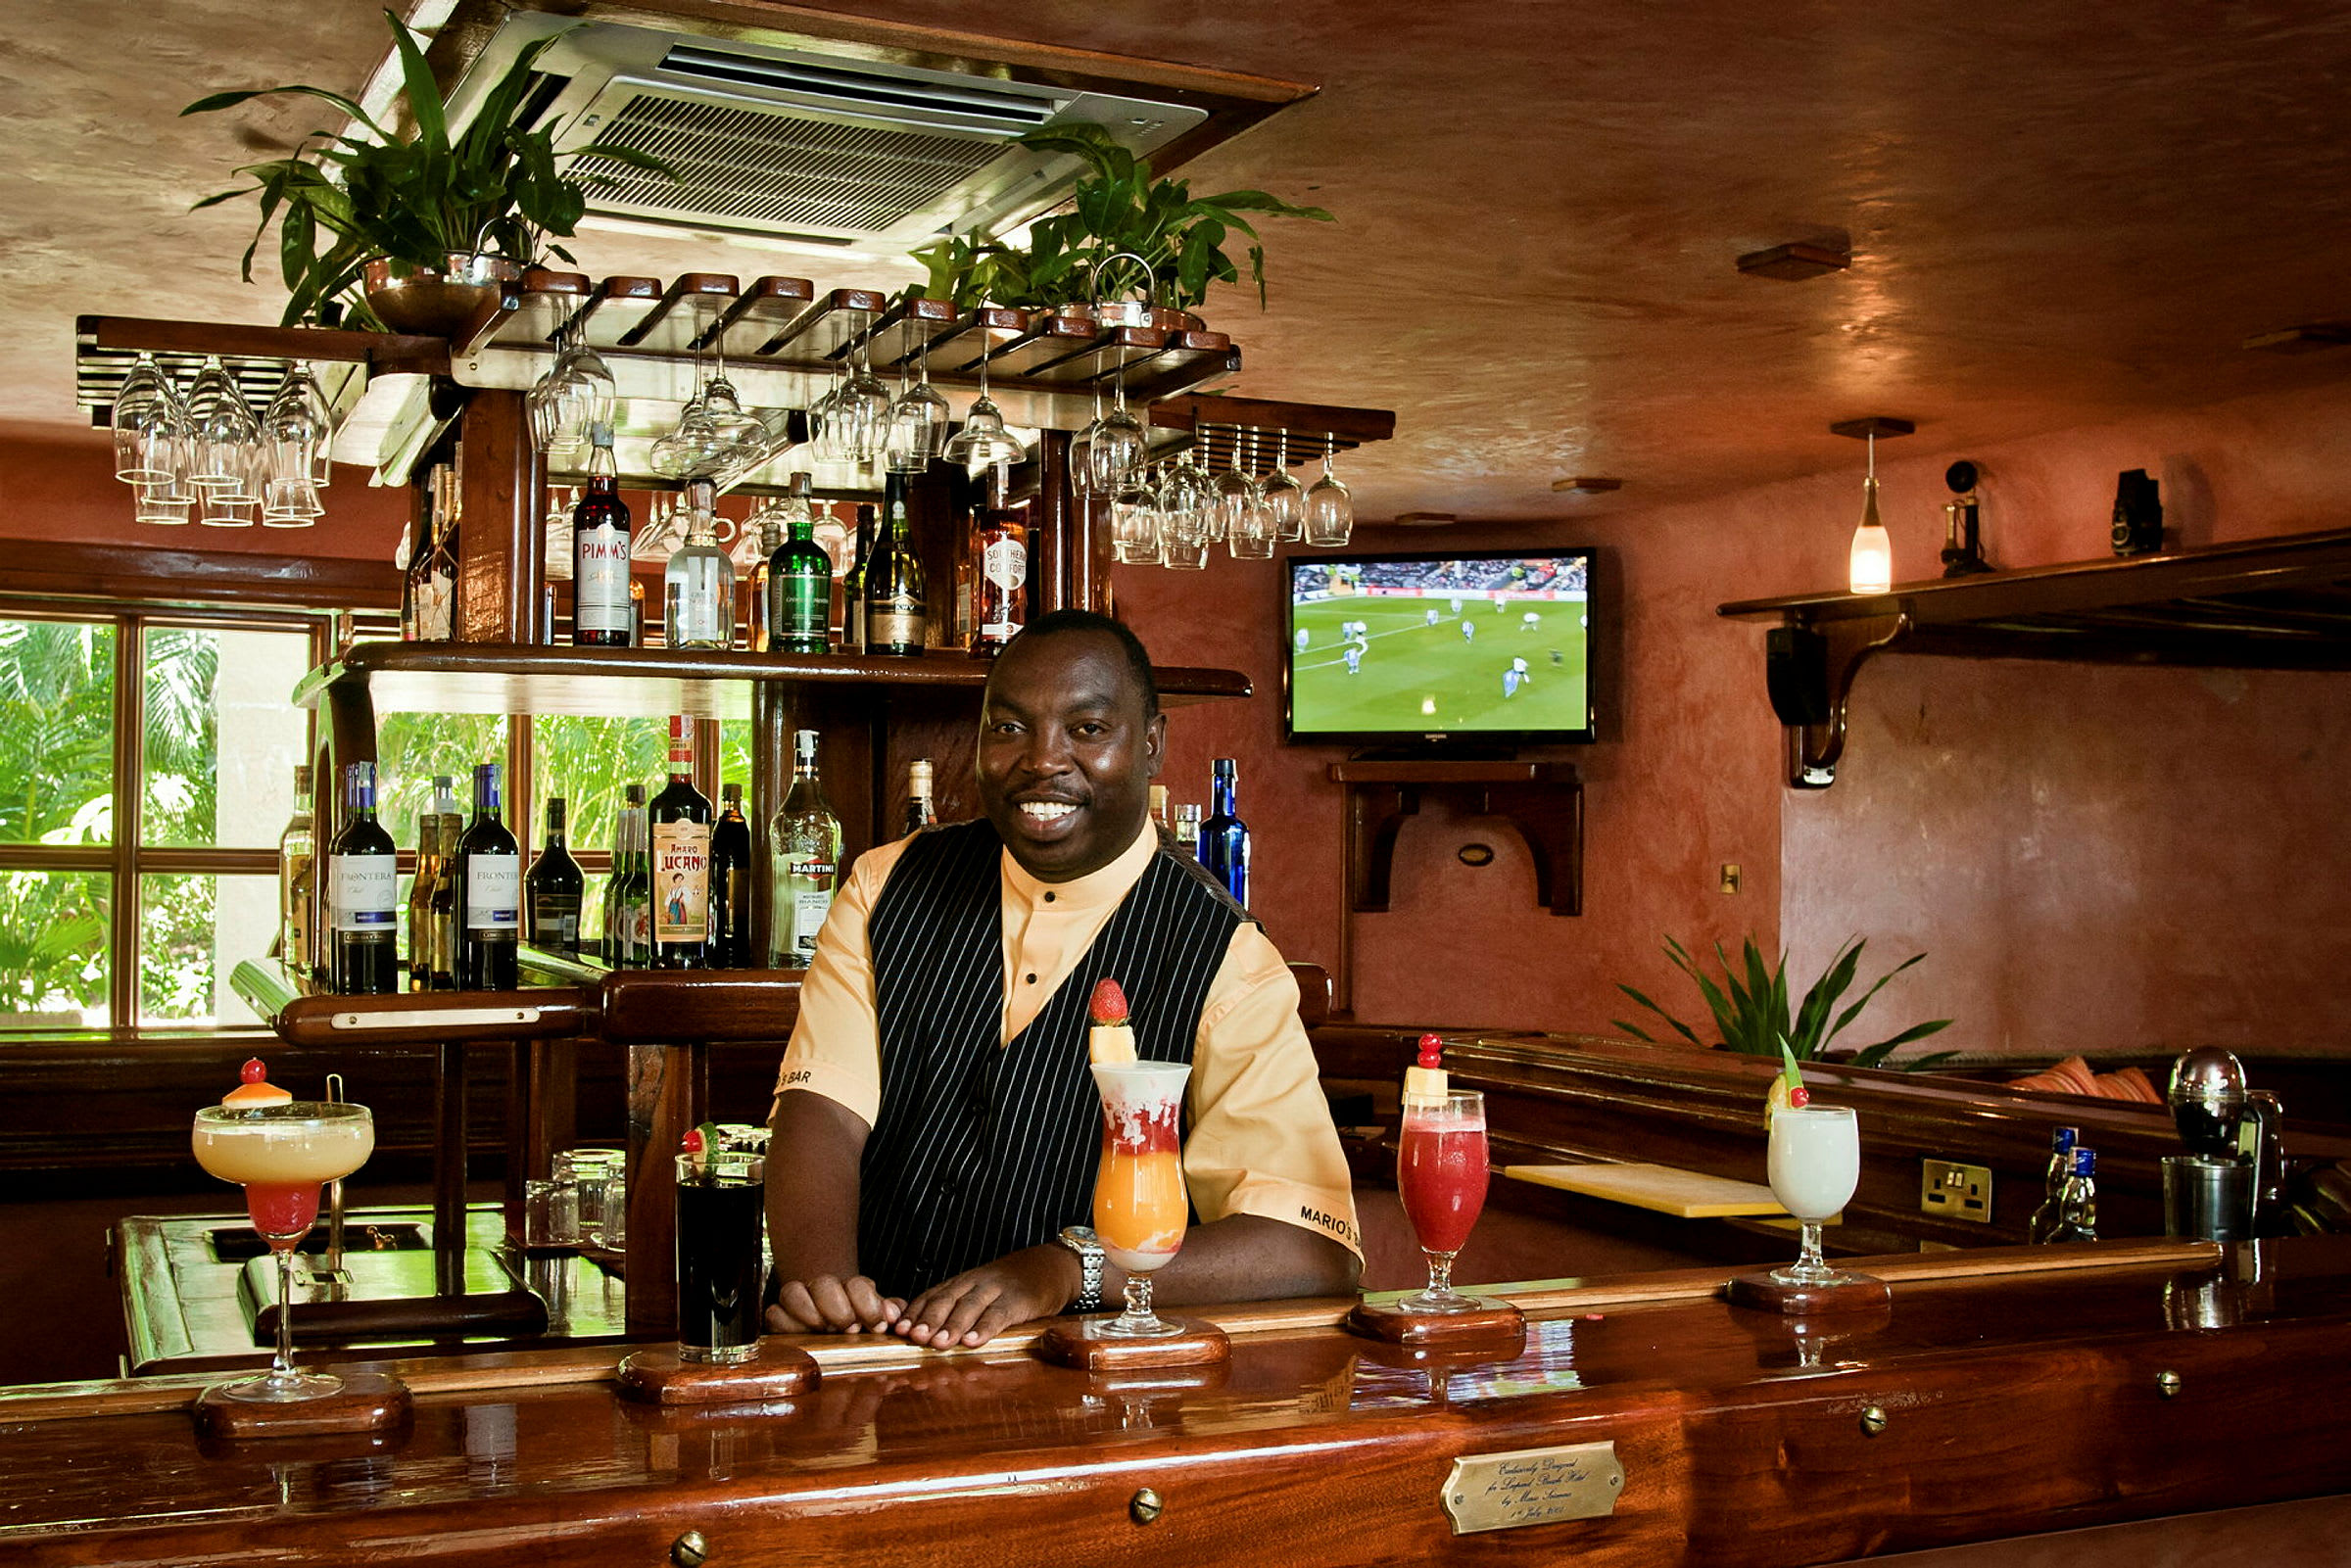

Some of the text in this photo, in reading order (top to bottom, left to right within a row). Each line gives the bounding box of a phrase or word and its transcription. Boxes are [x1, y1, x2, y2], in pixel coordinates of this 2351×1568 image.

[582, 541, 627, 560] PIMM'S
[988, 563, 1026, 573] COFORT
[792, 864, 834, 873] MARTINI
[788, 1070, 811, 1083] BAR
[1301, 1206, 1352, 1241] MARIO'S
